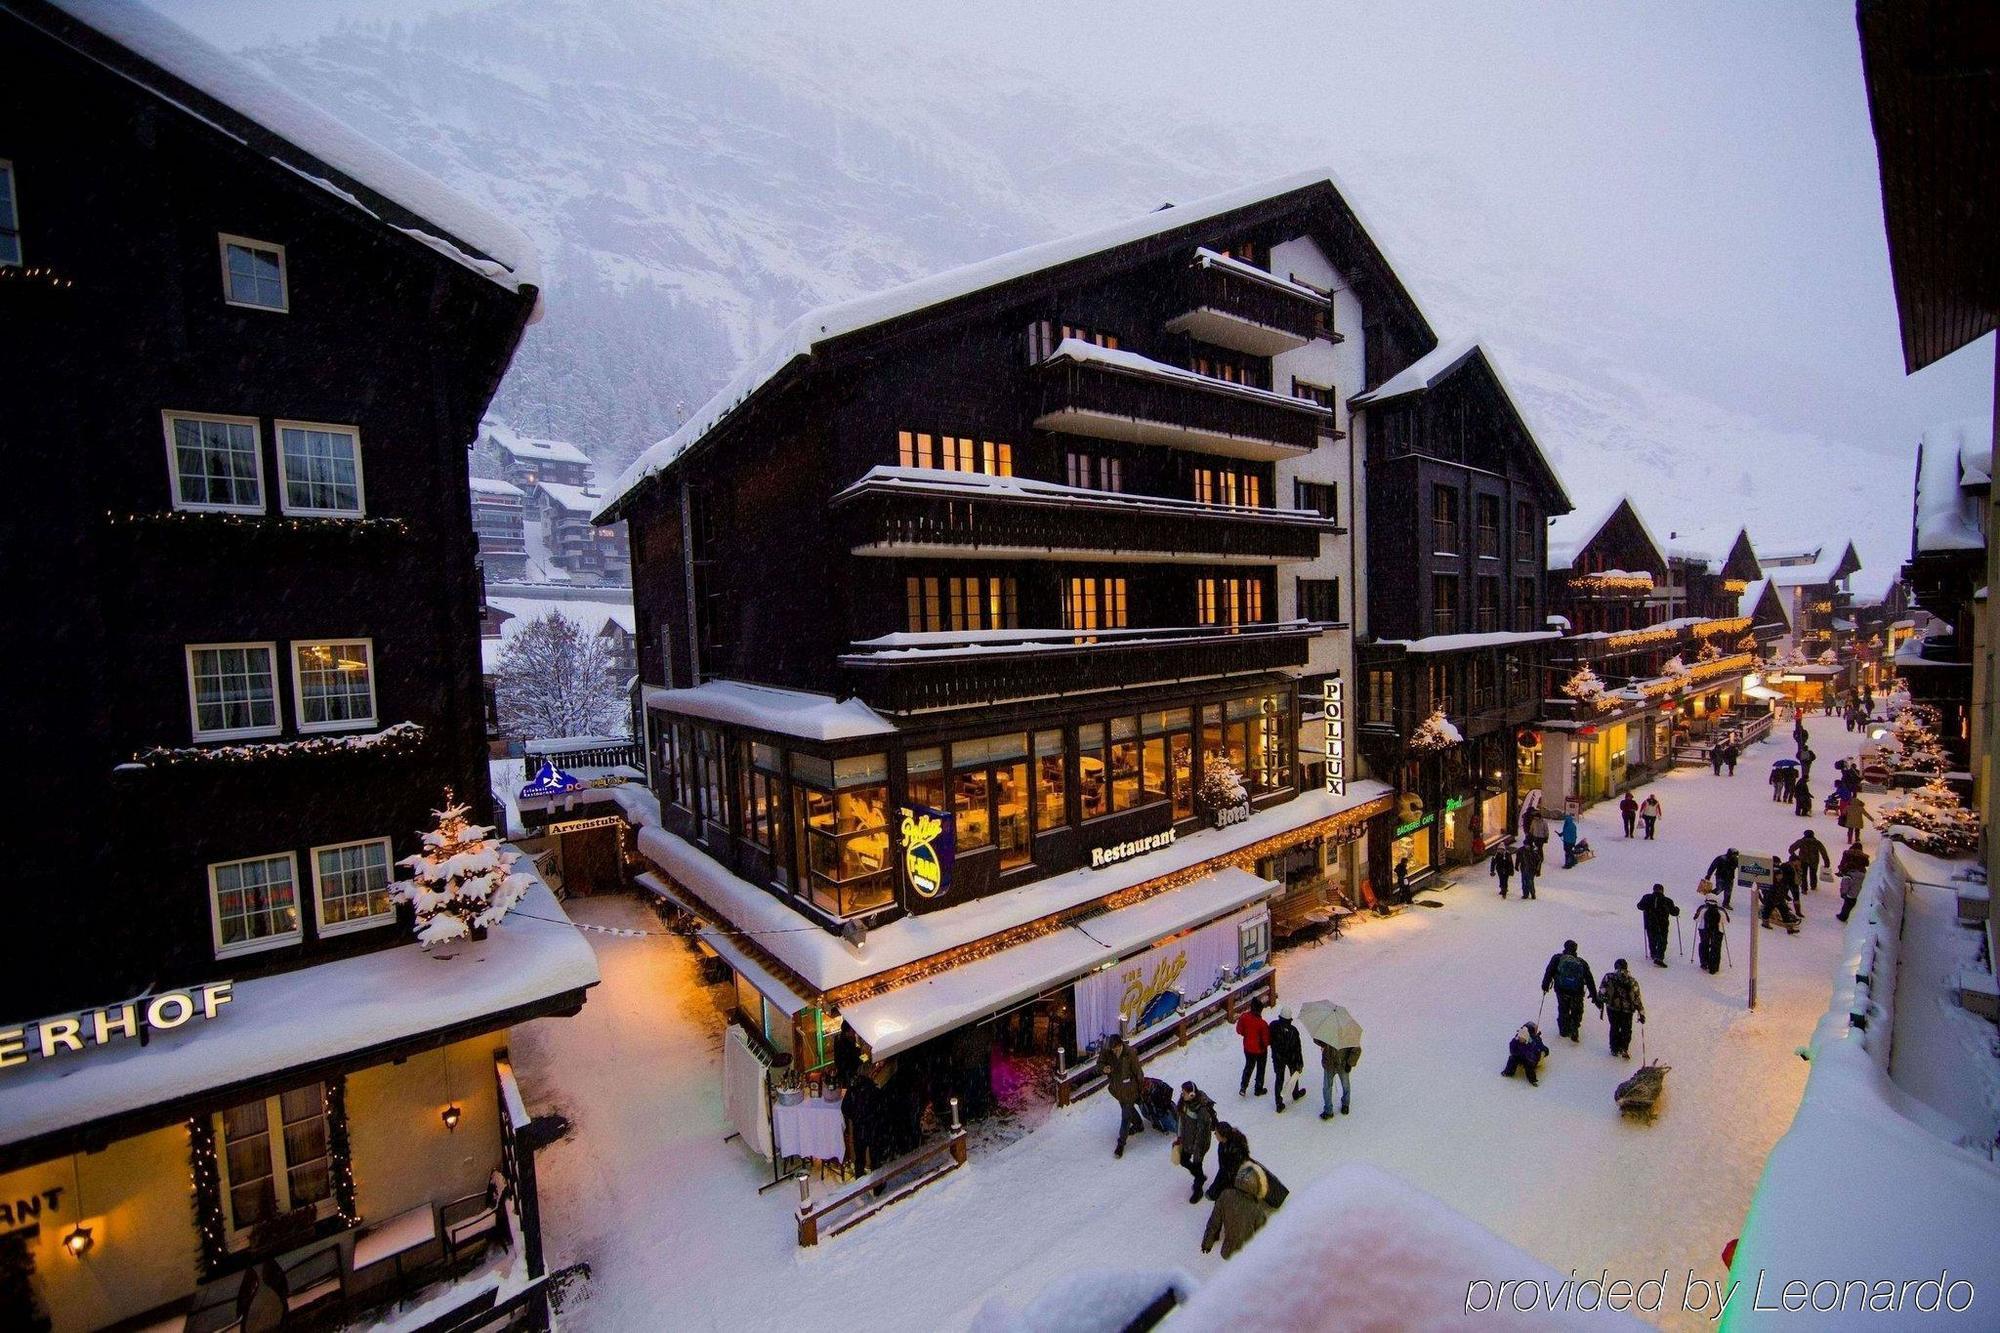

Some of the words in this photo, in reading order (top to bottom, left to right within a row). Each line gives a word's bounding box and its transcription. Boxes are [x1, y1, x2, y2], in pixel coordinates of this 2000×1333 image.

[1325, 684, 1342, 795] POLLUX
[552, 815, 621, 833] Arvenstube
[1217, 801, 1249, 827] Hotel
[1092, 828, 1176, 867] Restaurant
[1121, 967, 1142, 984] THE
[0, 981, 233, 1068] ERHOF
